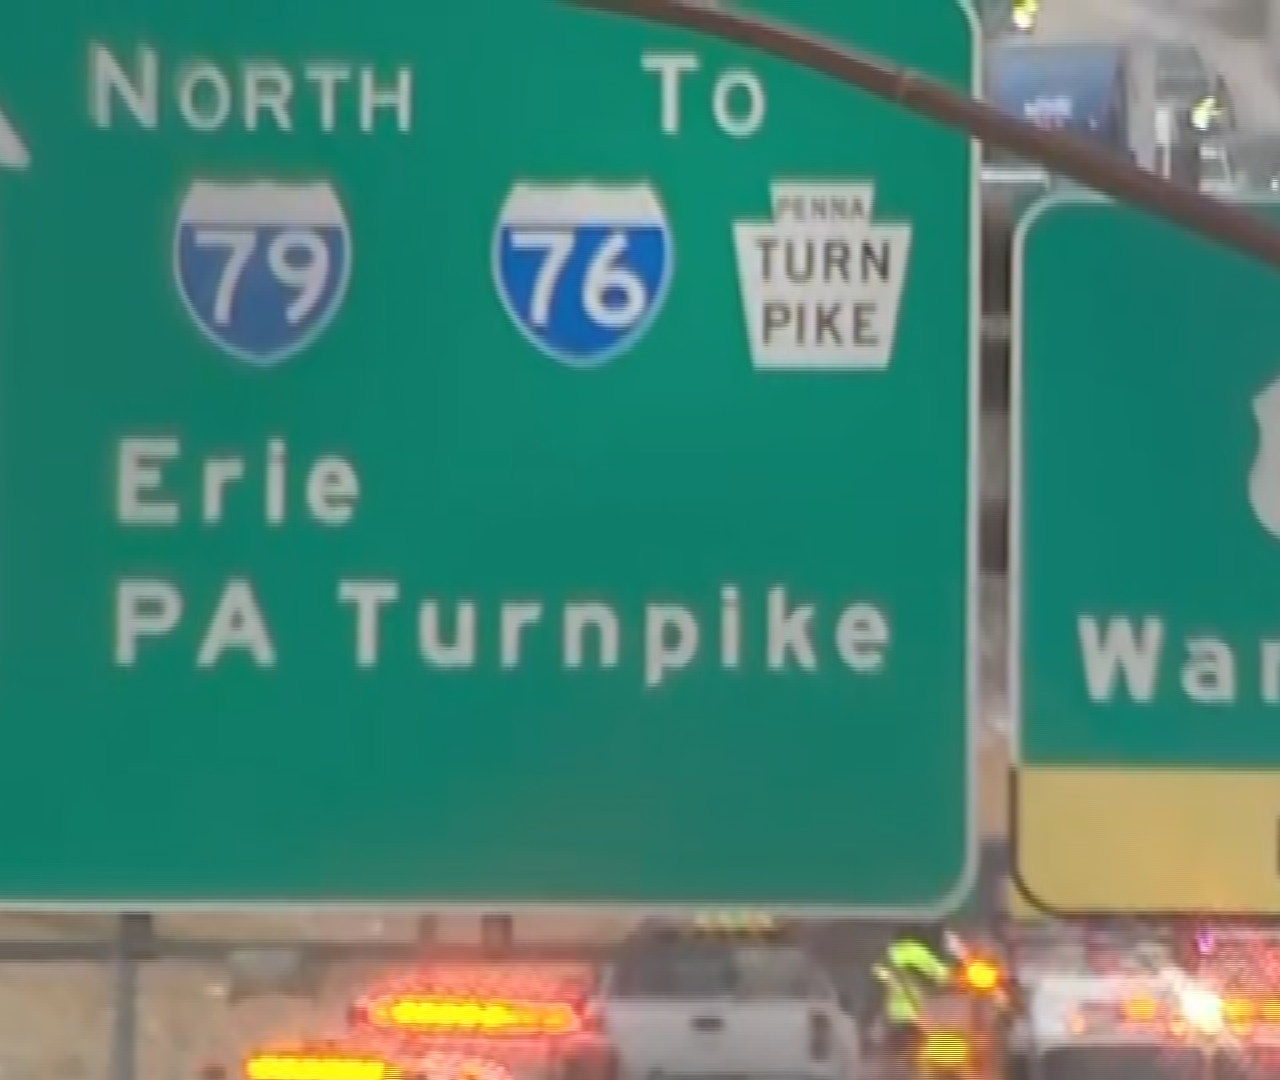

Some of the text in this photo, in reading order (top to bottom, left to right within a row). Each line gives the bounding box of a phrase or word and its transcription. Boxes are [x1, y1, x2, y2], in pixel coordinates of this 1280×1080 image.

[86, 44, 413, 132] NORTH
[776, 196, 866, 220] PENNA
[194, 230, 330, 326] 79
[511, 230, 647, 328] 76
[755, 239, 891, 284] TURN
[761, 303, 880, 346] PIKE
[117, 438, 360, 526] Erie
[116, 580, 890, 686] PA Turnpike
